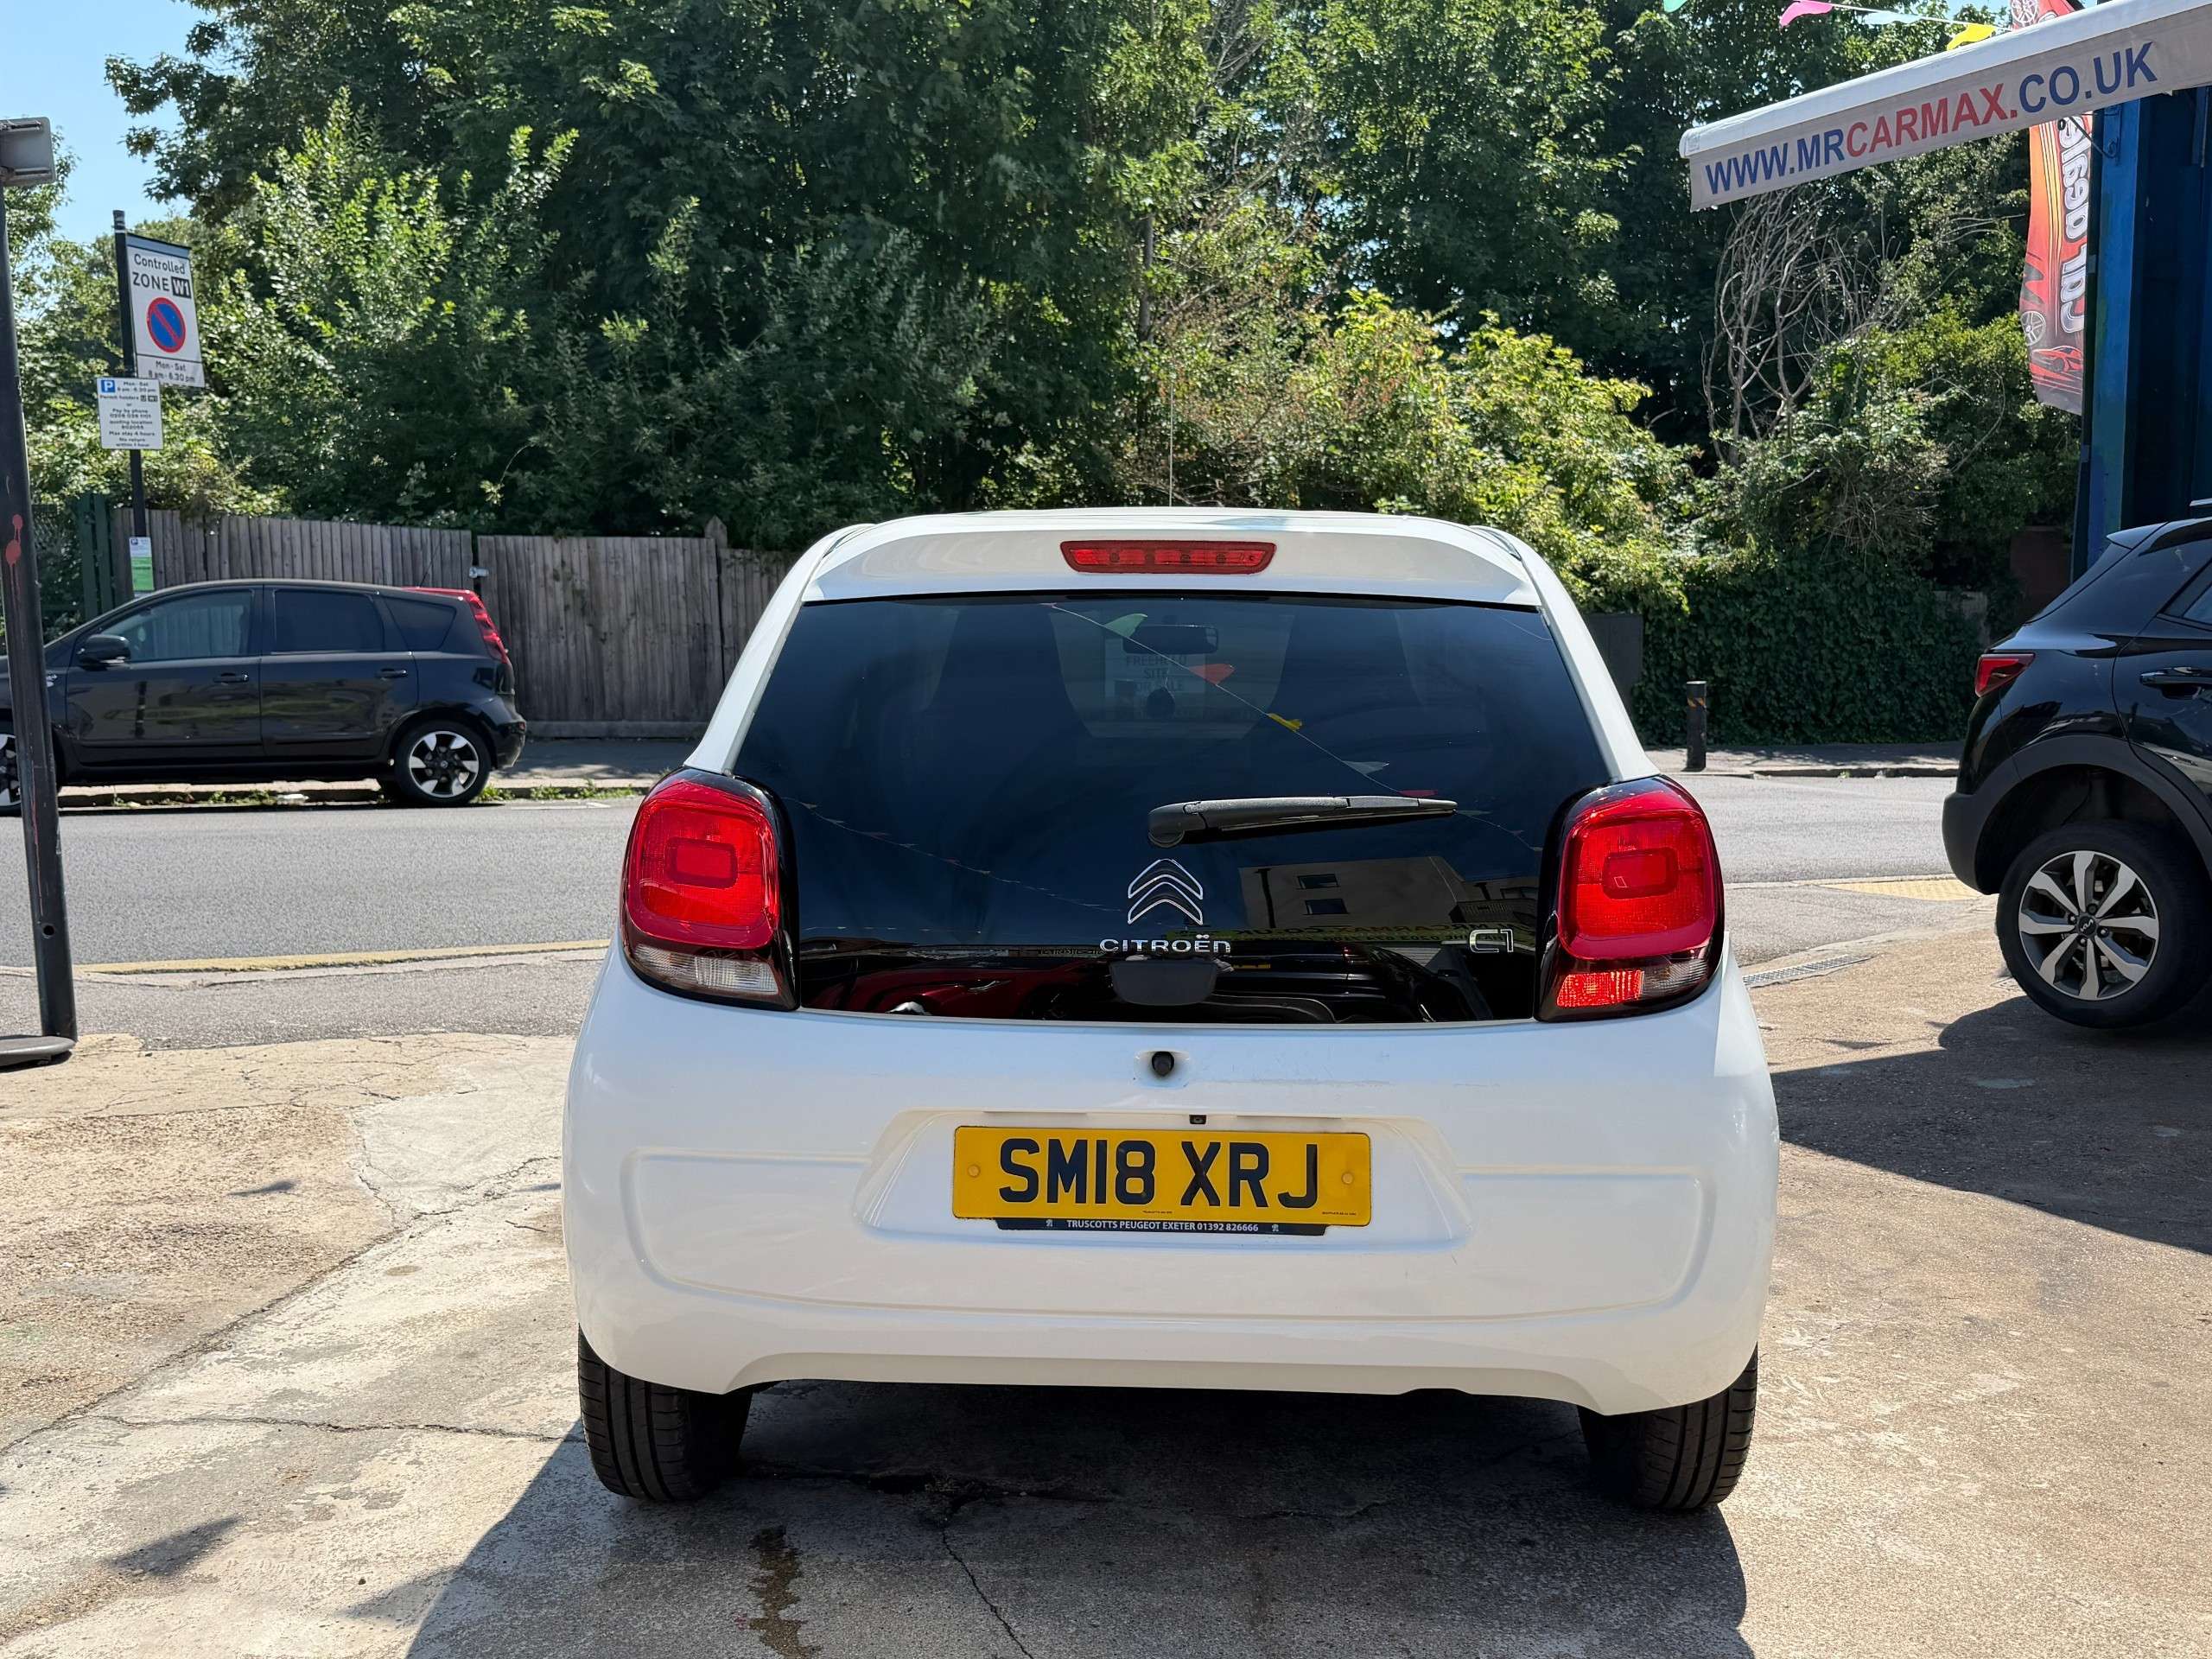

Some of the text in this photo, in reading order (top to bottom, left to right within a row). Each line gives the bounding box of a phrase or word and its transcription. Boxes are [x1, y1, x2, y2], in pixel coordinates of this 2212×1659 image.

[1705, 41, 2158, 194] WWW.MRCARMAX.CO.UK
[134, 253, 185, 275] Controlled
[132, 271, 190, 296] ZONE W1
[168, 372, 185, 382] 6.30
[1468, 927, 1516, 955] C1
[999, 1137, 1319, 1209] SM18 XRJ
[1066, 1219, 1259, 1233] TRUSCOTTS PEUGEOT EXETER 01392 826666
